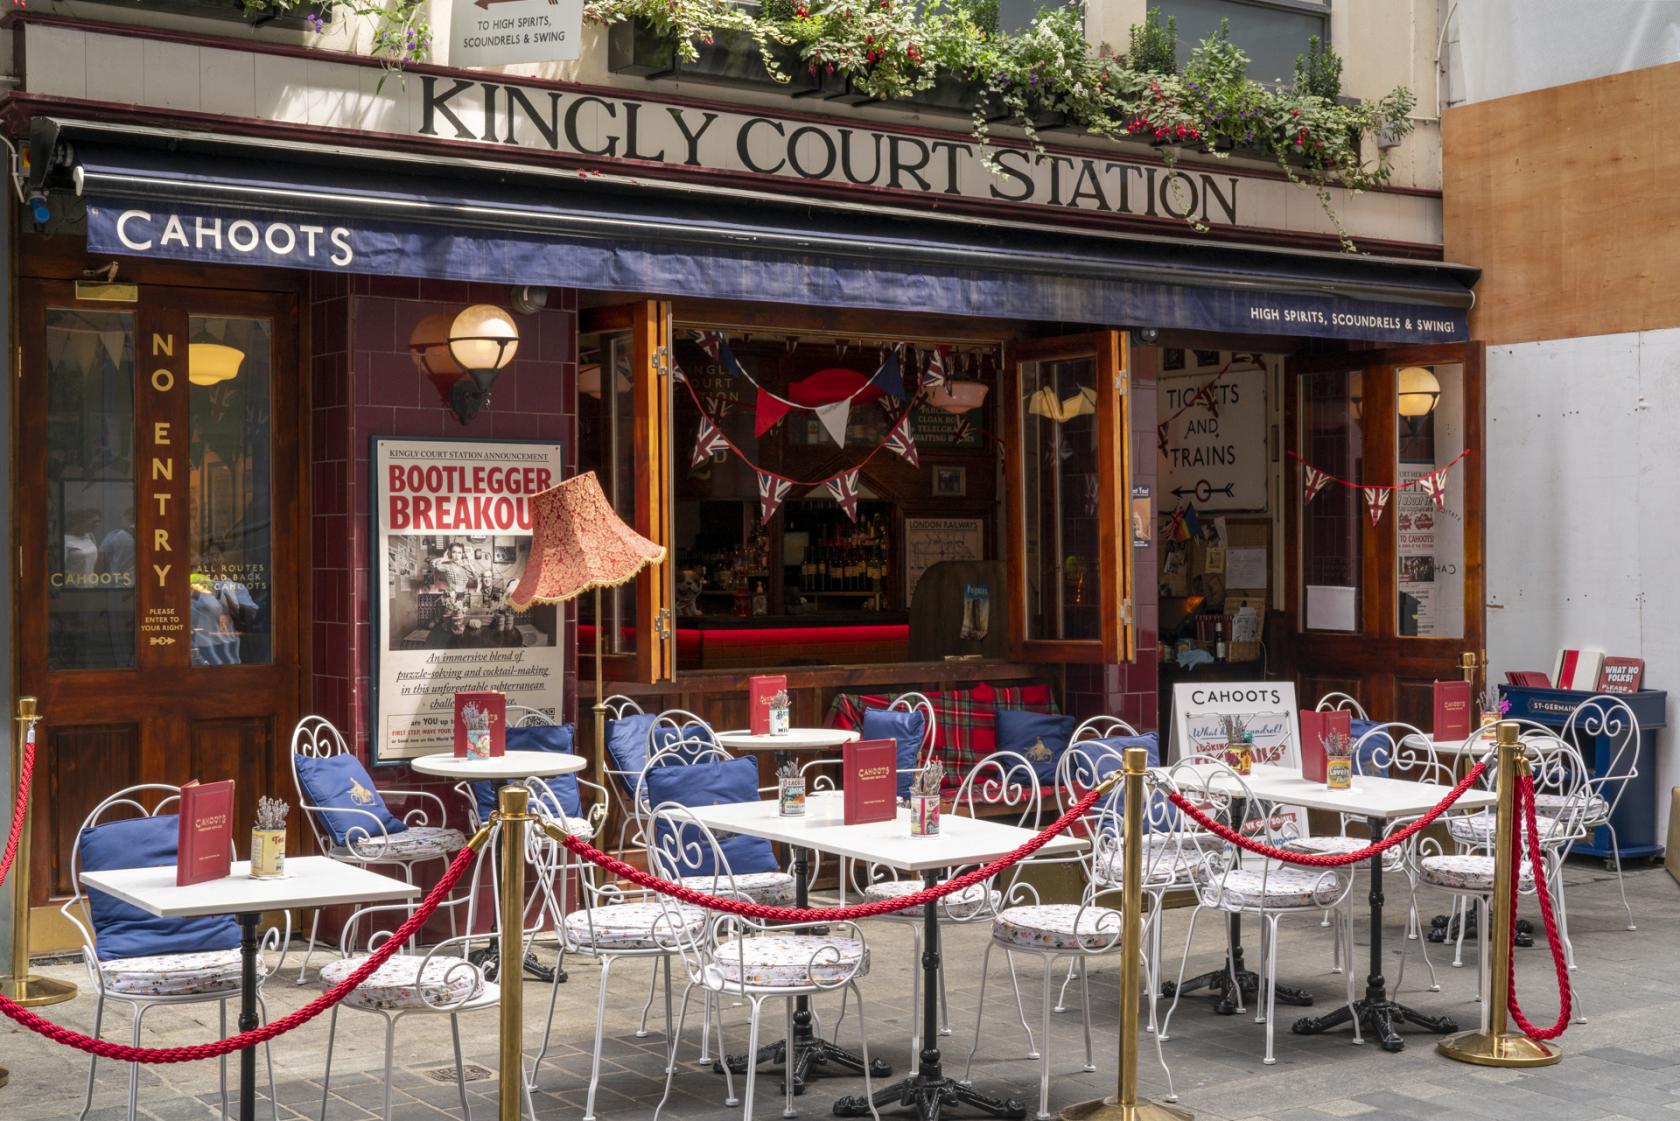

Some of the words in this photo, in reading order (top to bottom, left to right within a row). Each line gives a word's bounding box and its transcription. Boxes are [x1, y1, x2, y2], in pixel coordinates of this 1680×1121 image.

[478, 20, 489, 31] TO
[493, 18, 515, 30] HIGH
[518, 15, 552, 29] SPIRITS,
[463, 35, 521, 48] SCOUNDRELS
[523, 34, 531, 44] &
[533, 31, 565, 43] SWING
[418, 75, 718, 165] KINGLY
[736, 117, 973, 195] COURT
[989, 148, 1239, 226] STATION
[116, 209, 354, 267] CAHOOTS
[1250, 307, 1280, 320] HIGH
[1283, 310, 1328, 325] SPIRITS,
[1332, 313, 1401, 329] SCOUNDRELS
[1405, 317, 1413, 330] &
[1417, 319, 1455, 333] SWING!
[151, 333, 174, 392] NO
[1186, 418, 1219, 434] AND
[389, 449, 420, 458] KINGLY
[420, 450, 448, 459] COURT
[450, 451, 483, 460] STATION
[485, 452, 549, 461] ANNOUNCEMENT
[1170, 445, 1236, 468] TRAINS
[389, 464, 552, 495] BOOTLEGGER
[152, 422, 174, 587] ENTRY
[389, 495, 533, 531] BREAKOU
[196, 565, 216, 573] ALL
[221, 563, 265, 573] ROUTES
[51, 572, 133, 587] CAHOOTS
[232, 573, 262, 581] BACK
[141, 624, 161, 632] YOUR
[426, 652, 441, 664] An
[442, 651, 487, 663] immersive
[489, 650, 513, 662] blend
[514, 650, 527, 662] of
[396, 668, 462, 683] puzzle-solving
[463, 668, 481, 678] and
[482, 665, 550, 677] cocktail-making
[1605, 665, 1627, 674] WHAT
[1628, 666, 1639, 674] HO
[1608, 674, 1633, 683] FOLKS!
[401, 685, 411, 695] in
[413, 683, 431, 694] this
[431, 681, 488, 697] unforgettable
[490, 680, 545, 692] subterranean
[1192, 690, 1281, 705] CAHOOTS
[411, 719, 422, 727] are
[423, 717, 438, 726] YOU
[439, 719, 449, 727] up
[1193, 726, 1218, 738] What
[858, 767, 890, 777] CAHOOTS
